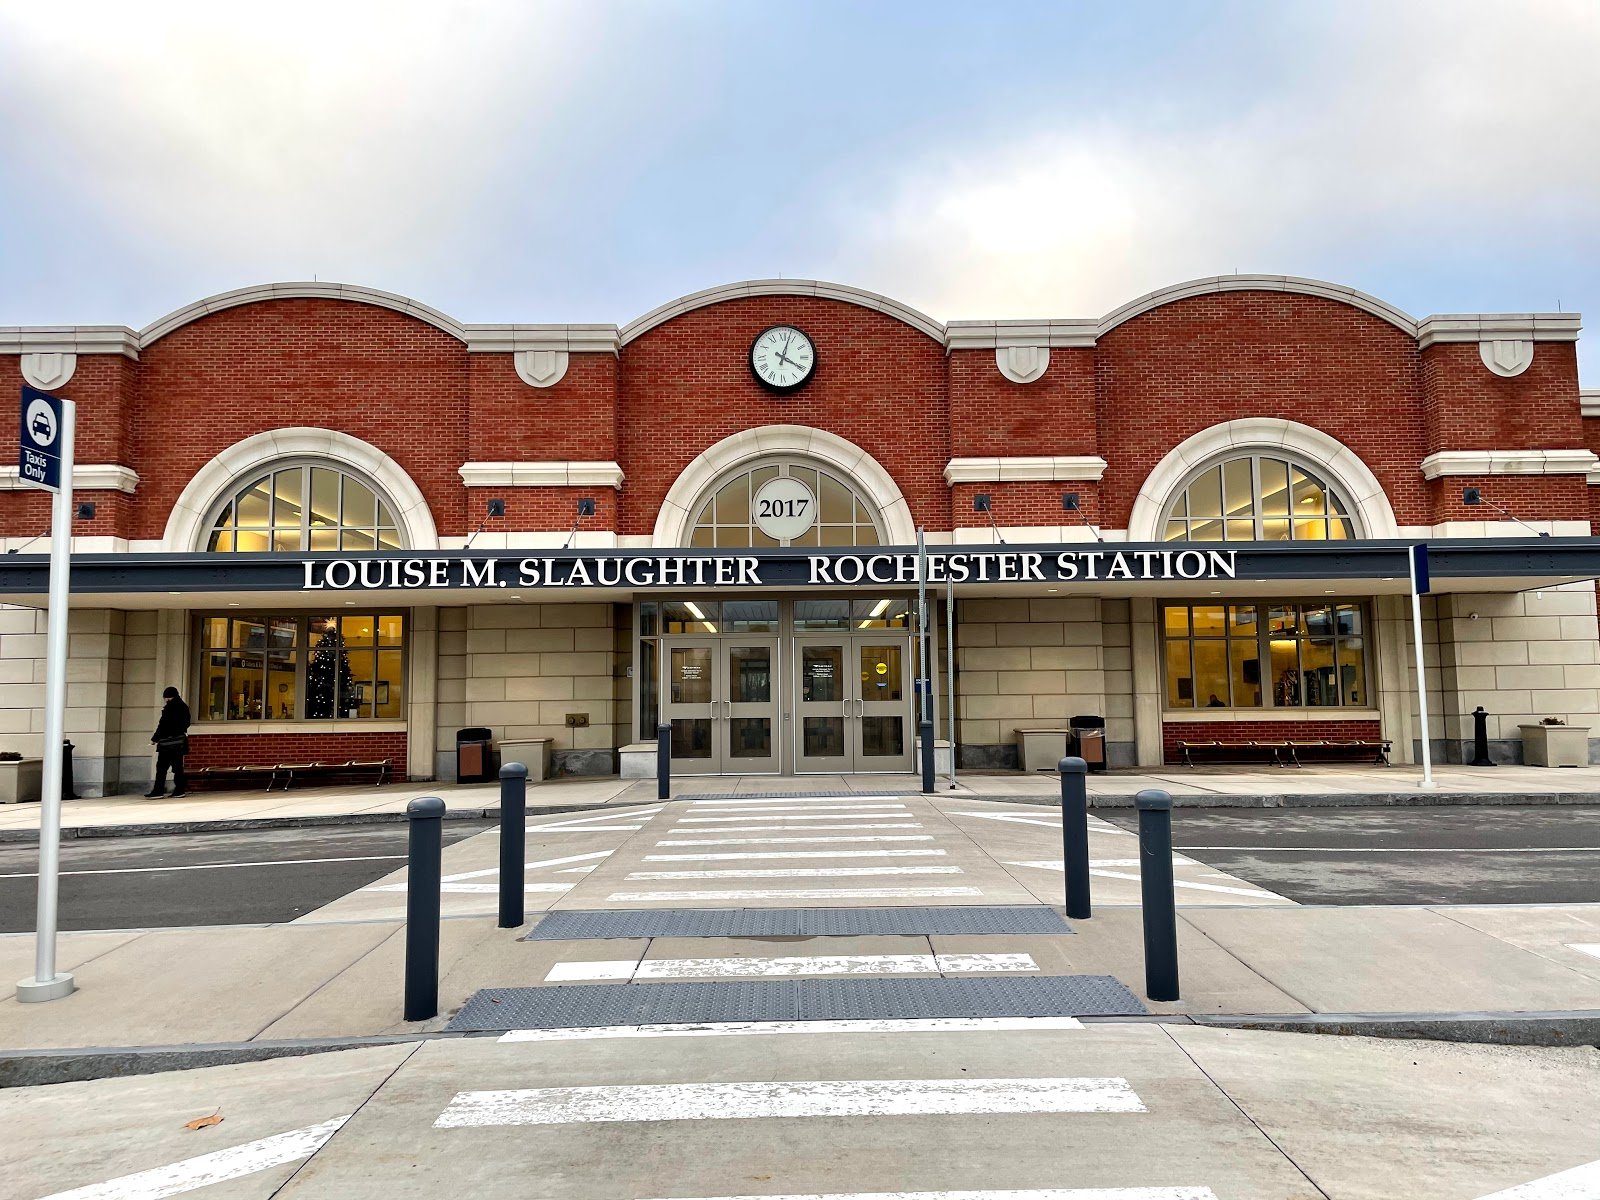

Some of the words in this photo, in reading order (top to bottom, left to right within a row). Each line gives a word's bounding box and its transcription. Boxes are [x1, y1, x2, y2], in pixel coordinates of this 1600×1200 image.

[25, 450, 47, 467] Taxis
[25, 464, 46, 482] Only
[759, 499, 809, 518] 2017
[302, 559, 450, 589] LOUISE
[460, 558, 507, 588] M.
[518, 557, 763, 587] SLAUGHTER
[807, 553, 1047, 584] ROCHESTER
[1057, 550, 1238, 580] STATION
